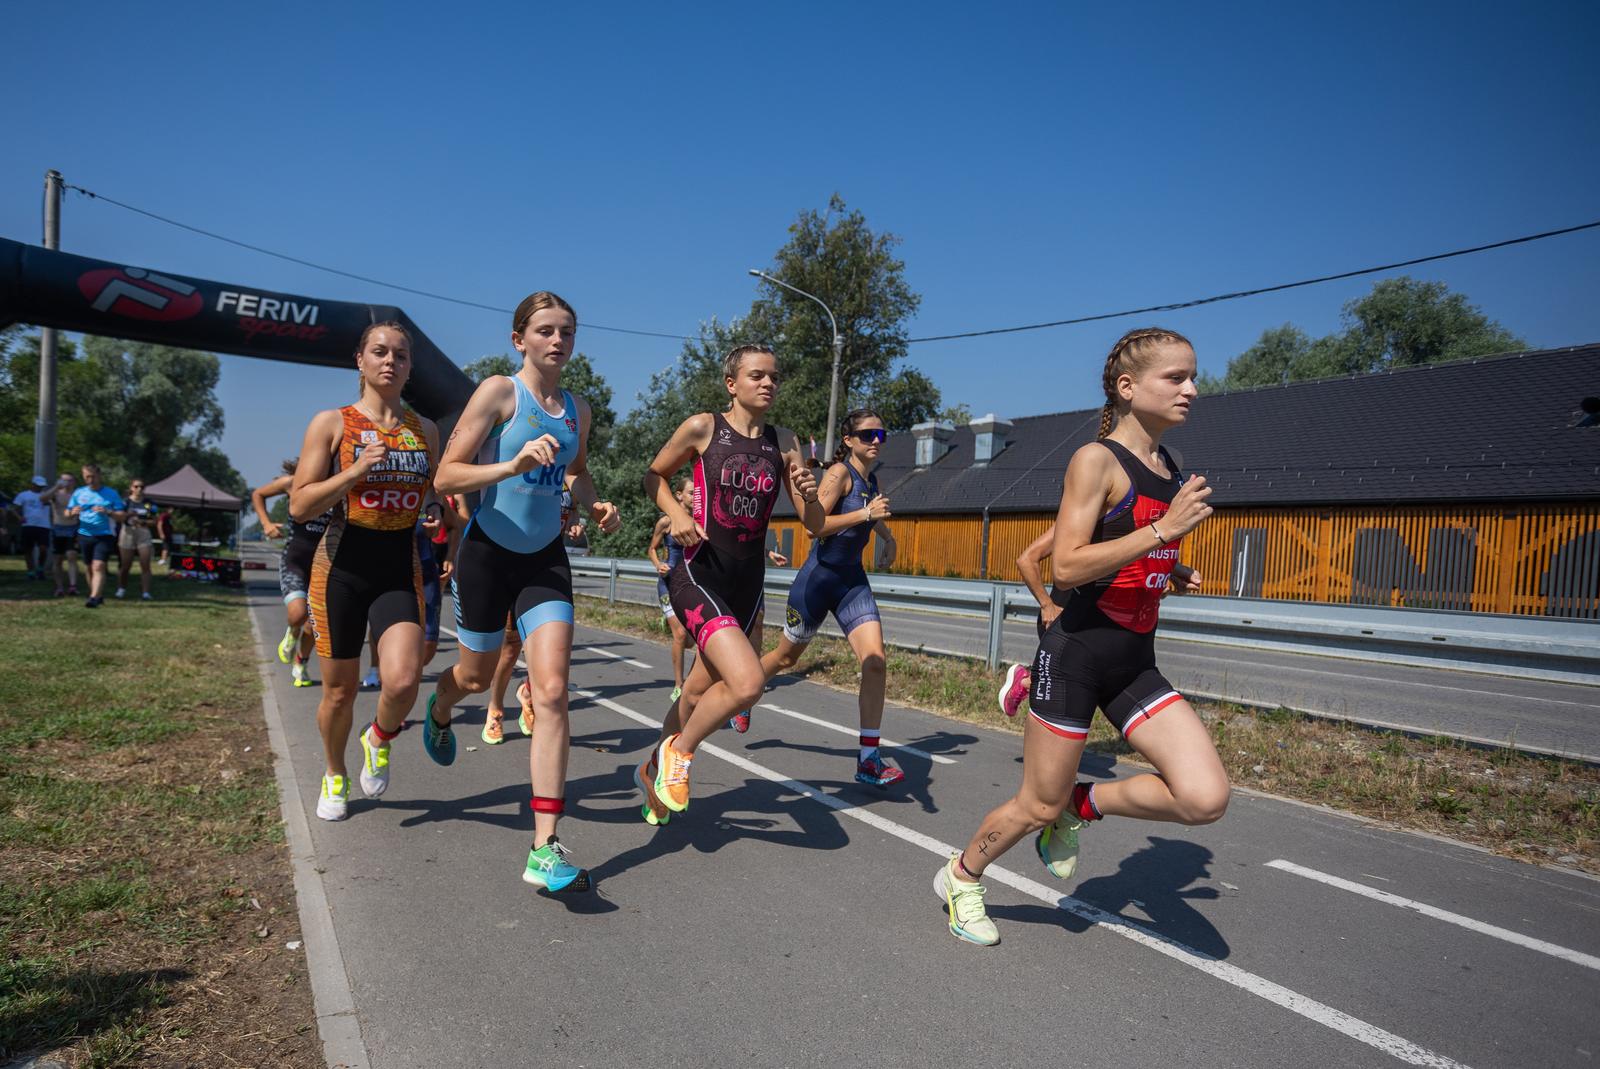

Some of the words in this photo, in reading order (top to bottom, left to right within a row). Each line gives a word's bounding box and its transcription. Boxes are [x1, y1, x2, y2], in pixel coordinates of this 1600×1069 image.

[216, 291, 319, 325] FERIVI
[239, 317, 328, 343] sport
[366, 474, 393, 483] CLUB
[522, 463, 566, 486] CRO
[720, 468, 774, 493] LUČIĆ
[360, 489, 420, 509] CRO
[732, 494, 758, 519] CRO
